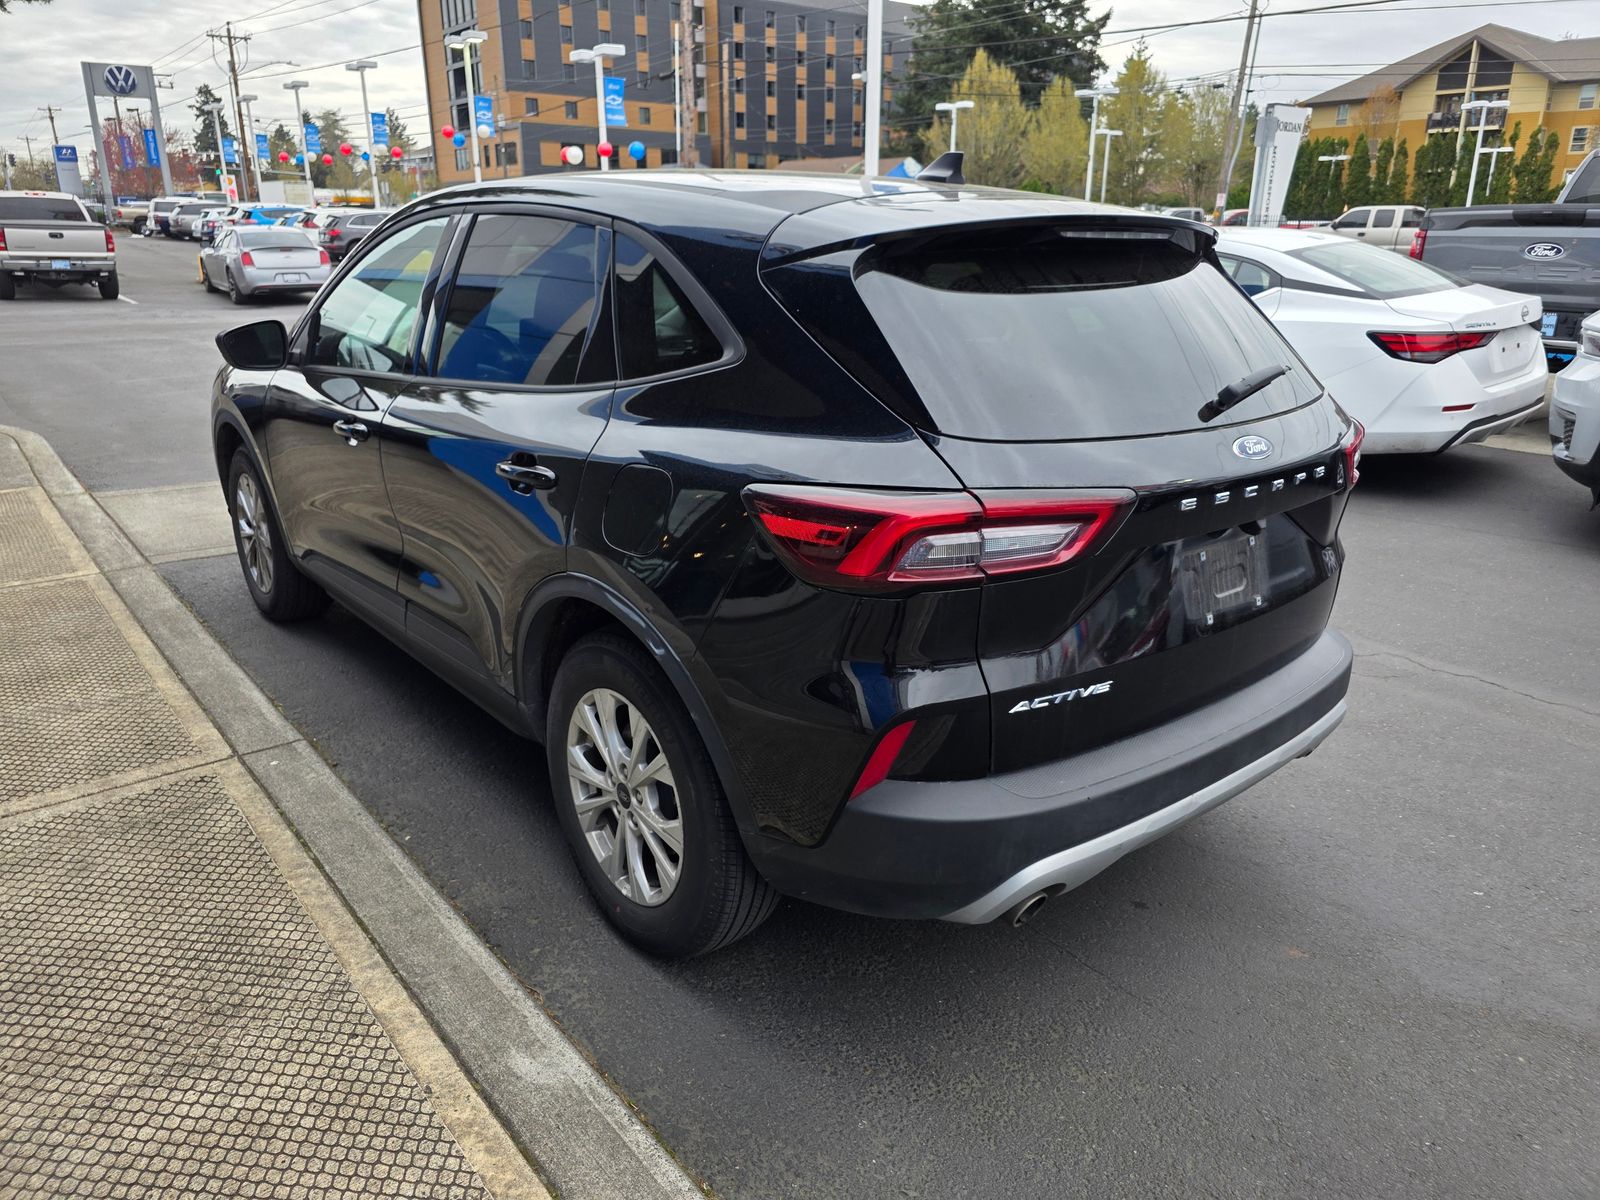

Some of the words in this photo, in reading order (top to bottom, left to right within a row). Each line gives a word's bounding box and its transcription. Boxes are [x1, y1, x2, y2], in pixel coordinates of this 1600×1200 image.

[1276, 120, 1302, 133] JORDAN
[1529, 245, 1559, 257] Ford
[1241, 438, 1269, 455] Ford
[1181, 466, 1325, 511] ESCAPE
[1008, 680, 1113, 714] ACTIVE
